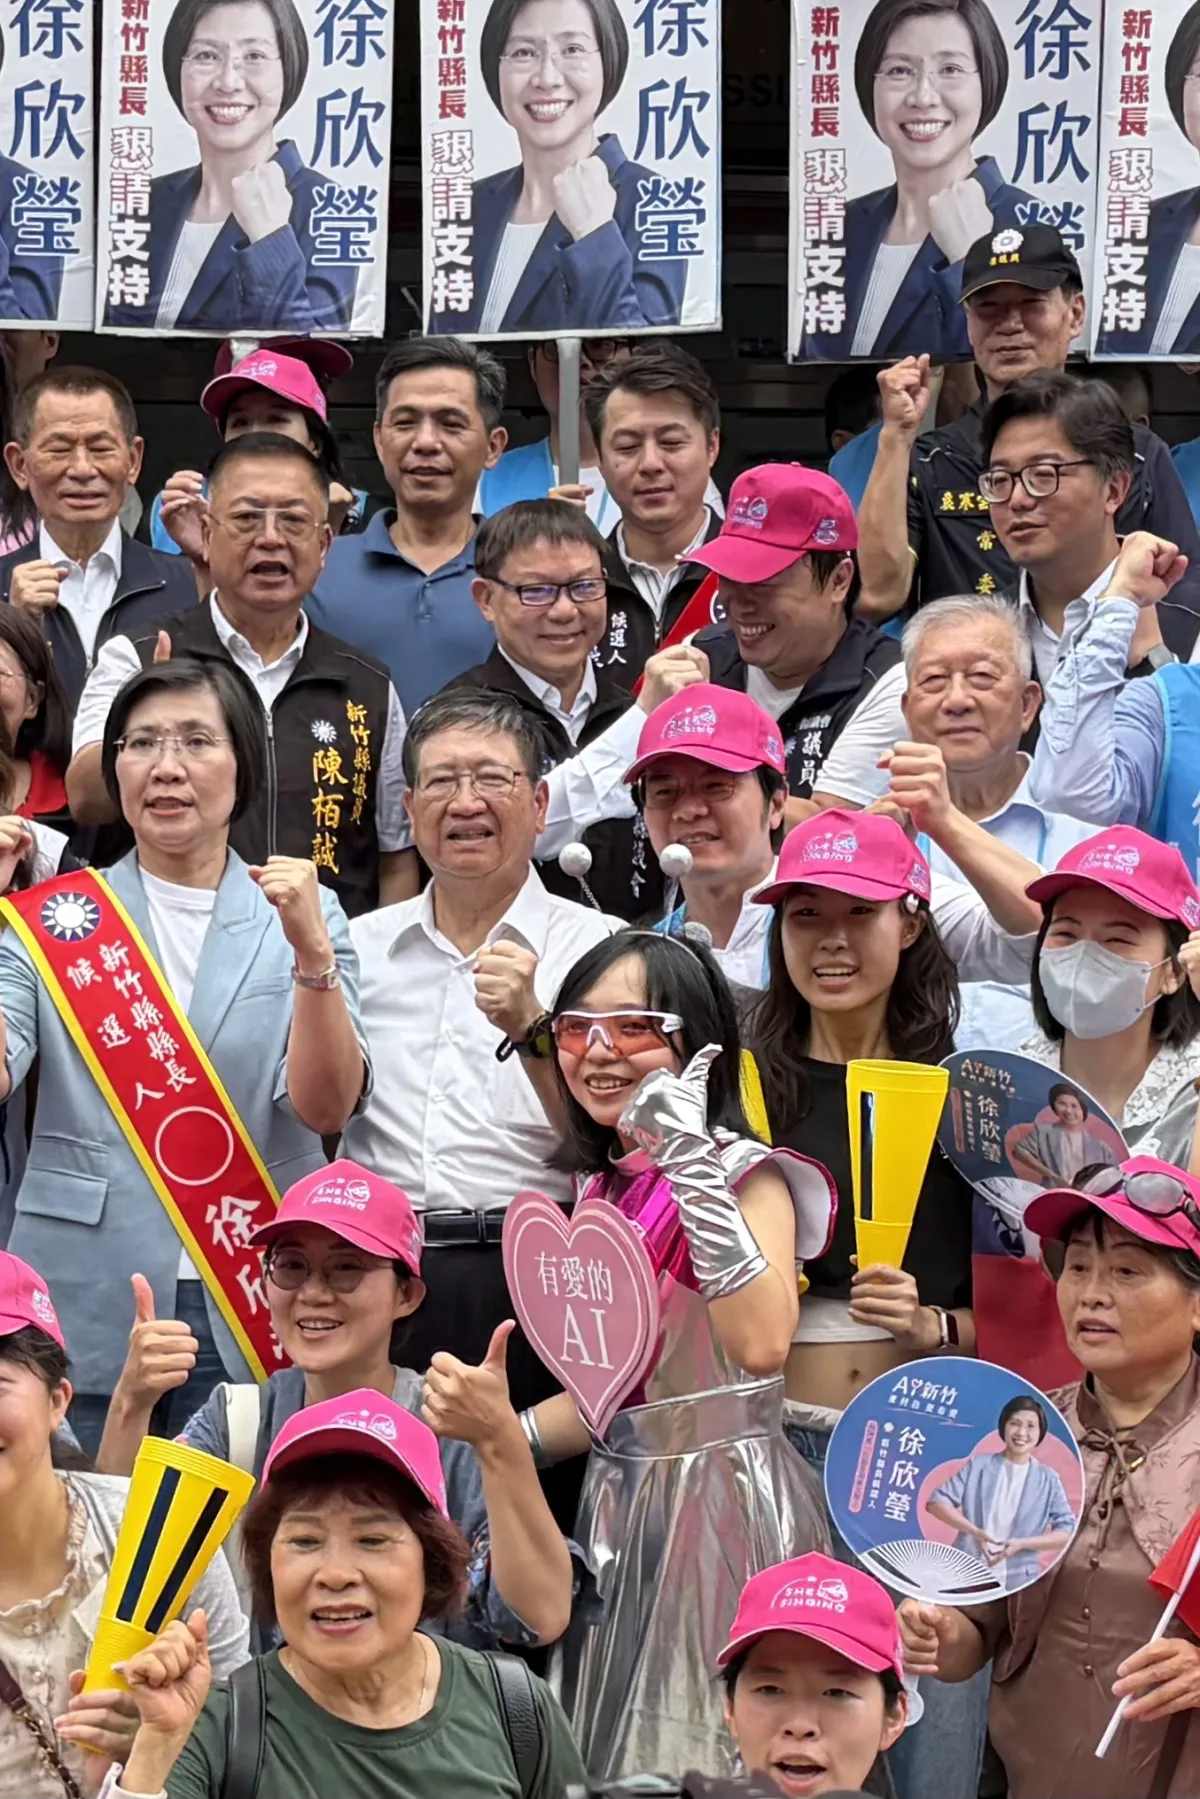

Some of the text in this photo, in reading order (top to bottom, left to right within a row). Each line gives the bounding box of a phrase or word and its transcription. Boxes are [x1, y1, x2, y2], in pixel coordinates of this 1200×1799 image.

[119, 0, 150, 117] 新竹縣長
[436, 0, 467, 120] 新竹縣長
[810, 6, 841, 138] 新竹縣長
[1117, 9, 1154, 138] 新竹縣長
[8, 0, 86, 257] 徐欣瑩
[308, 0, 388, 268] 徐欣瑩
[633, 0, 712, 263] 徐欣瑩
[108, 126, 154, 308] 懇請支持
[430, 130, 475, 314] 懇請支持
[803, 148, 848, 335] 懇請支持
[1101, 148, 1154, 333] 懇請支持
[607, 611, 628, 665] 候選人
[797, 730, 824, 788] 議員
[66, 957, 165, 1111] 候選人
[99, 939, 197, 1093] 新竹縣縣長
[534, 1250, 614, 1305] 有愛的
[559, 1303, 616, 1370] AI
[883, 1426, 926, 1522] 徐欣瑩
[785, 1587, 817, 1597] SHE
